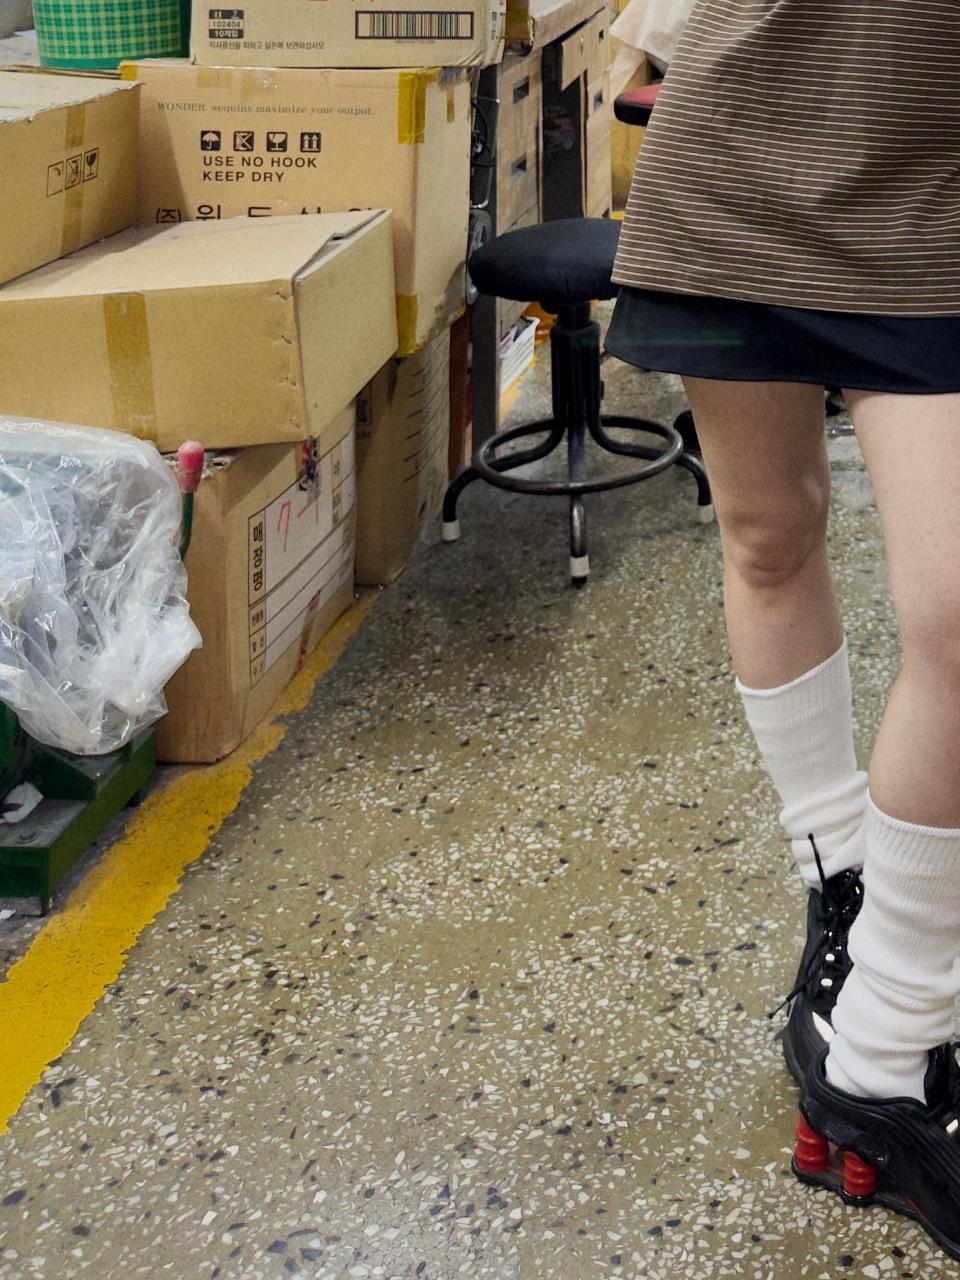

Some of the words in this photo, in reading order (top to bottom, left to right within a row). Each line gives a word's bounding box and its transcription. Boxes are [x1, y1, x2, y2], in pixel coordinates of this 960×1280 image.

[256, 104, 306, 114] maximize
[311, 106, 333, 115] your
[203, 156, 234, 167] USE
[242, 156, 264, 167] NO
[271, 157, 317, 168] HOOK
[203, 171, 244, 182] KEEP
[252, 172, 285, 182] DRY
